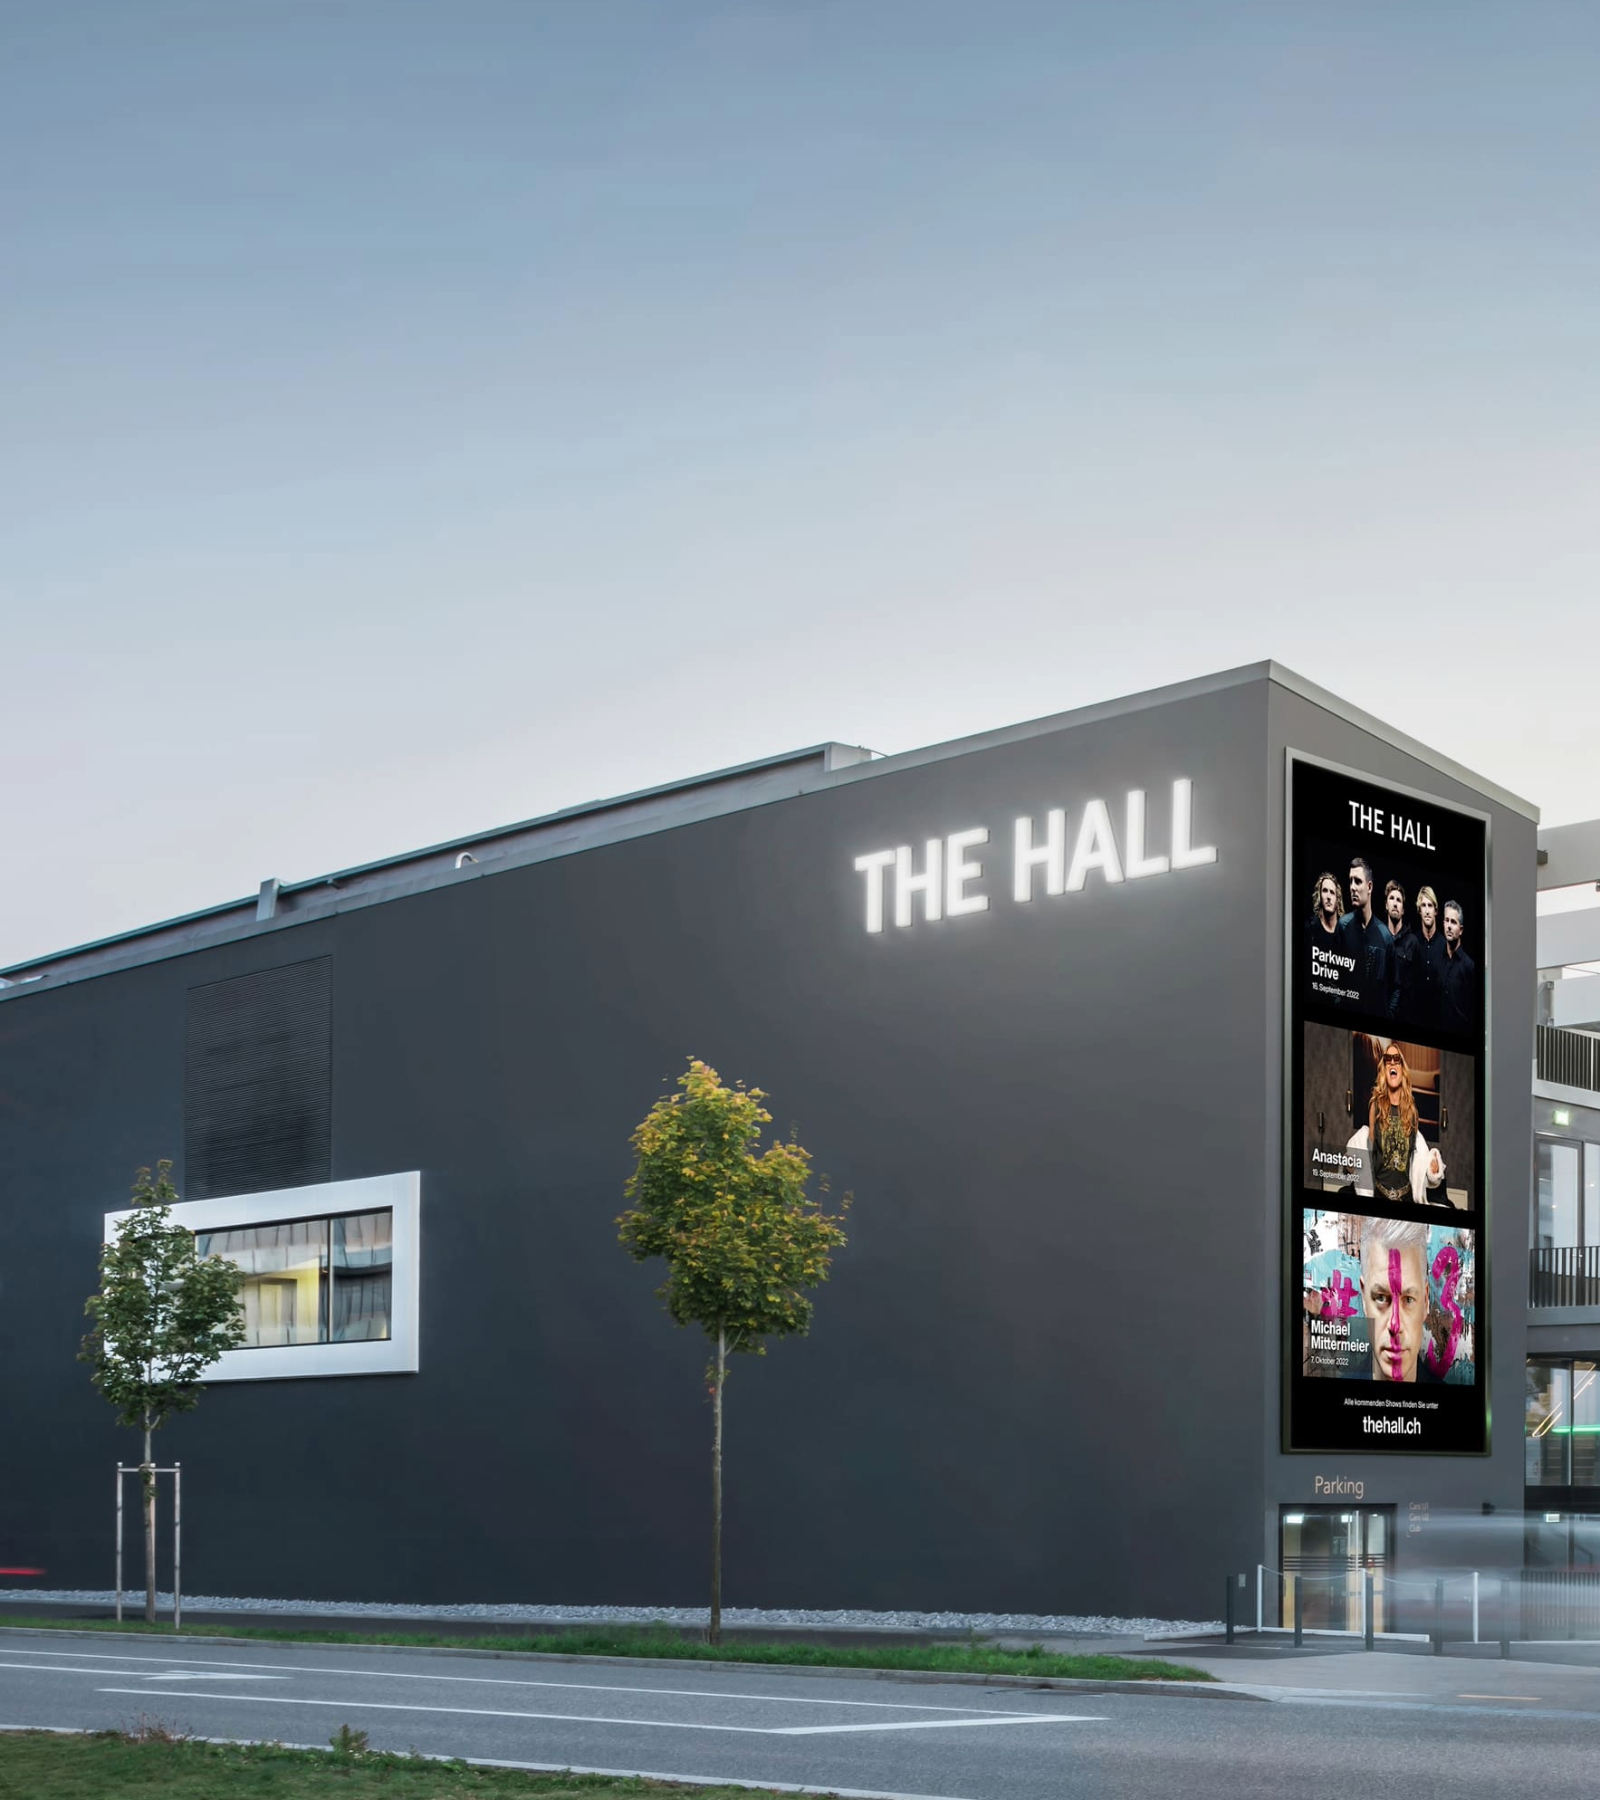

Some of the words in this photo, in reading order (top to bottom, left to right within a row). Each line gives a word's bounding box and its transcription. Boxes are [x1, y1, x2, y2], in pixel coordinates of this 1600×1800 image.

[1348, 800, 1385, 836] THE
[1391, 813, 1436, 851] HALL
[854, 827, 990, 934] THE
[1014, 778, 1219, 903] HALL
[1312, 945, 1356, 972] Parkway
[1312, 961, 1339, 980] Drive
[1319, 983, 1346, 996] September
[1346, 989, 1360, 1000] 2022
[1312, 1148, 1363, 1169] Anastacia
[1319, 1169, 1346, 1180] September
[1346, 1174, 1360, 1183] 2022
[1311, 1319, 1351, 1336] Michael
[1311, 1335, 1370, 1353] Mittermeier
[1316, 1356, 1336, 1366] Oktober
[1336, 1357, 1350, 1366] 2022
[1344, 1398, 1354, 1406] Alle
[1354, 1398, 1386, 1407] kommenden
[1385, 1399, 1402, 1408] Shows
[1402, 1400, 1418, 1409] finden
[1426, 1402, 1439, 1410] unter
[1362, 1415, 1422, 1435] thehall.ch
[1314, 1475, 1364, 1500] Parking
